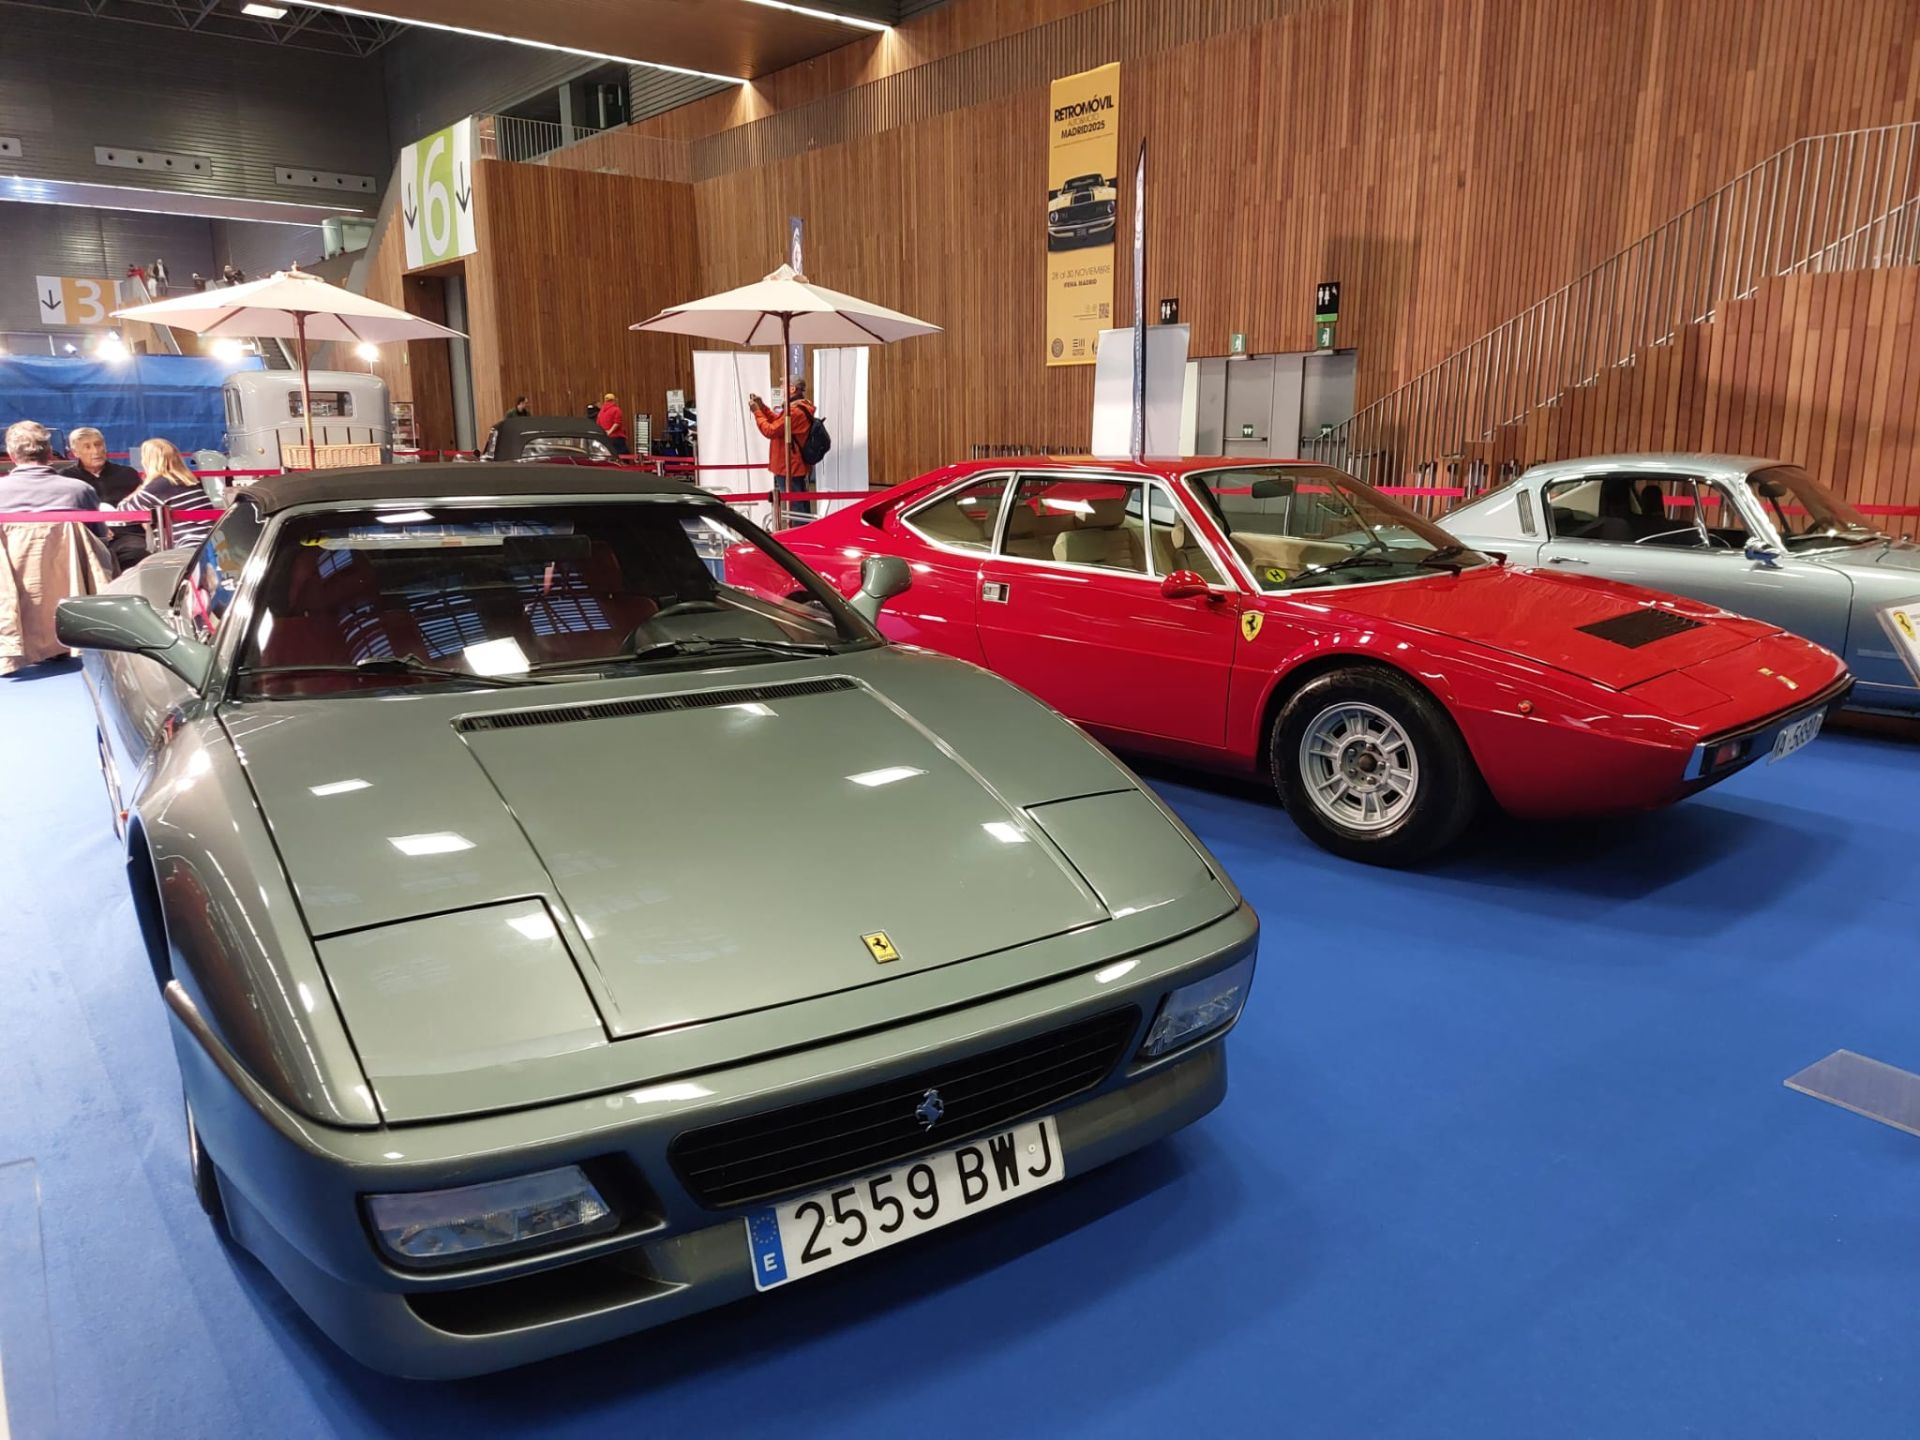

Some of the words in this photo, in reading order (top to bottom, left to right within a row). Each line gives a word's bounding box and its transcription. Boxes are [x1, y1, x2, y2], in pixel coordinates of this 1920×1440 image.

[1054, 94, 1114, 122] RETROMÓVIL
[1061, 120, 1105, 139] MADRID2025
[423, 136, 450, 256] 6
[75, 279, 105, 324] 3
[1269, 570, 1283, 580] H
[763, 1253, 778, 1272] E
[794, 1164, 940, 1264] 2559
[955, 1122, 1051, 1205] BWJ
